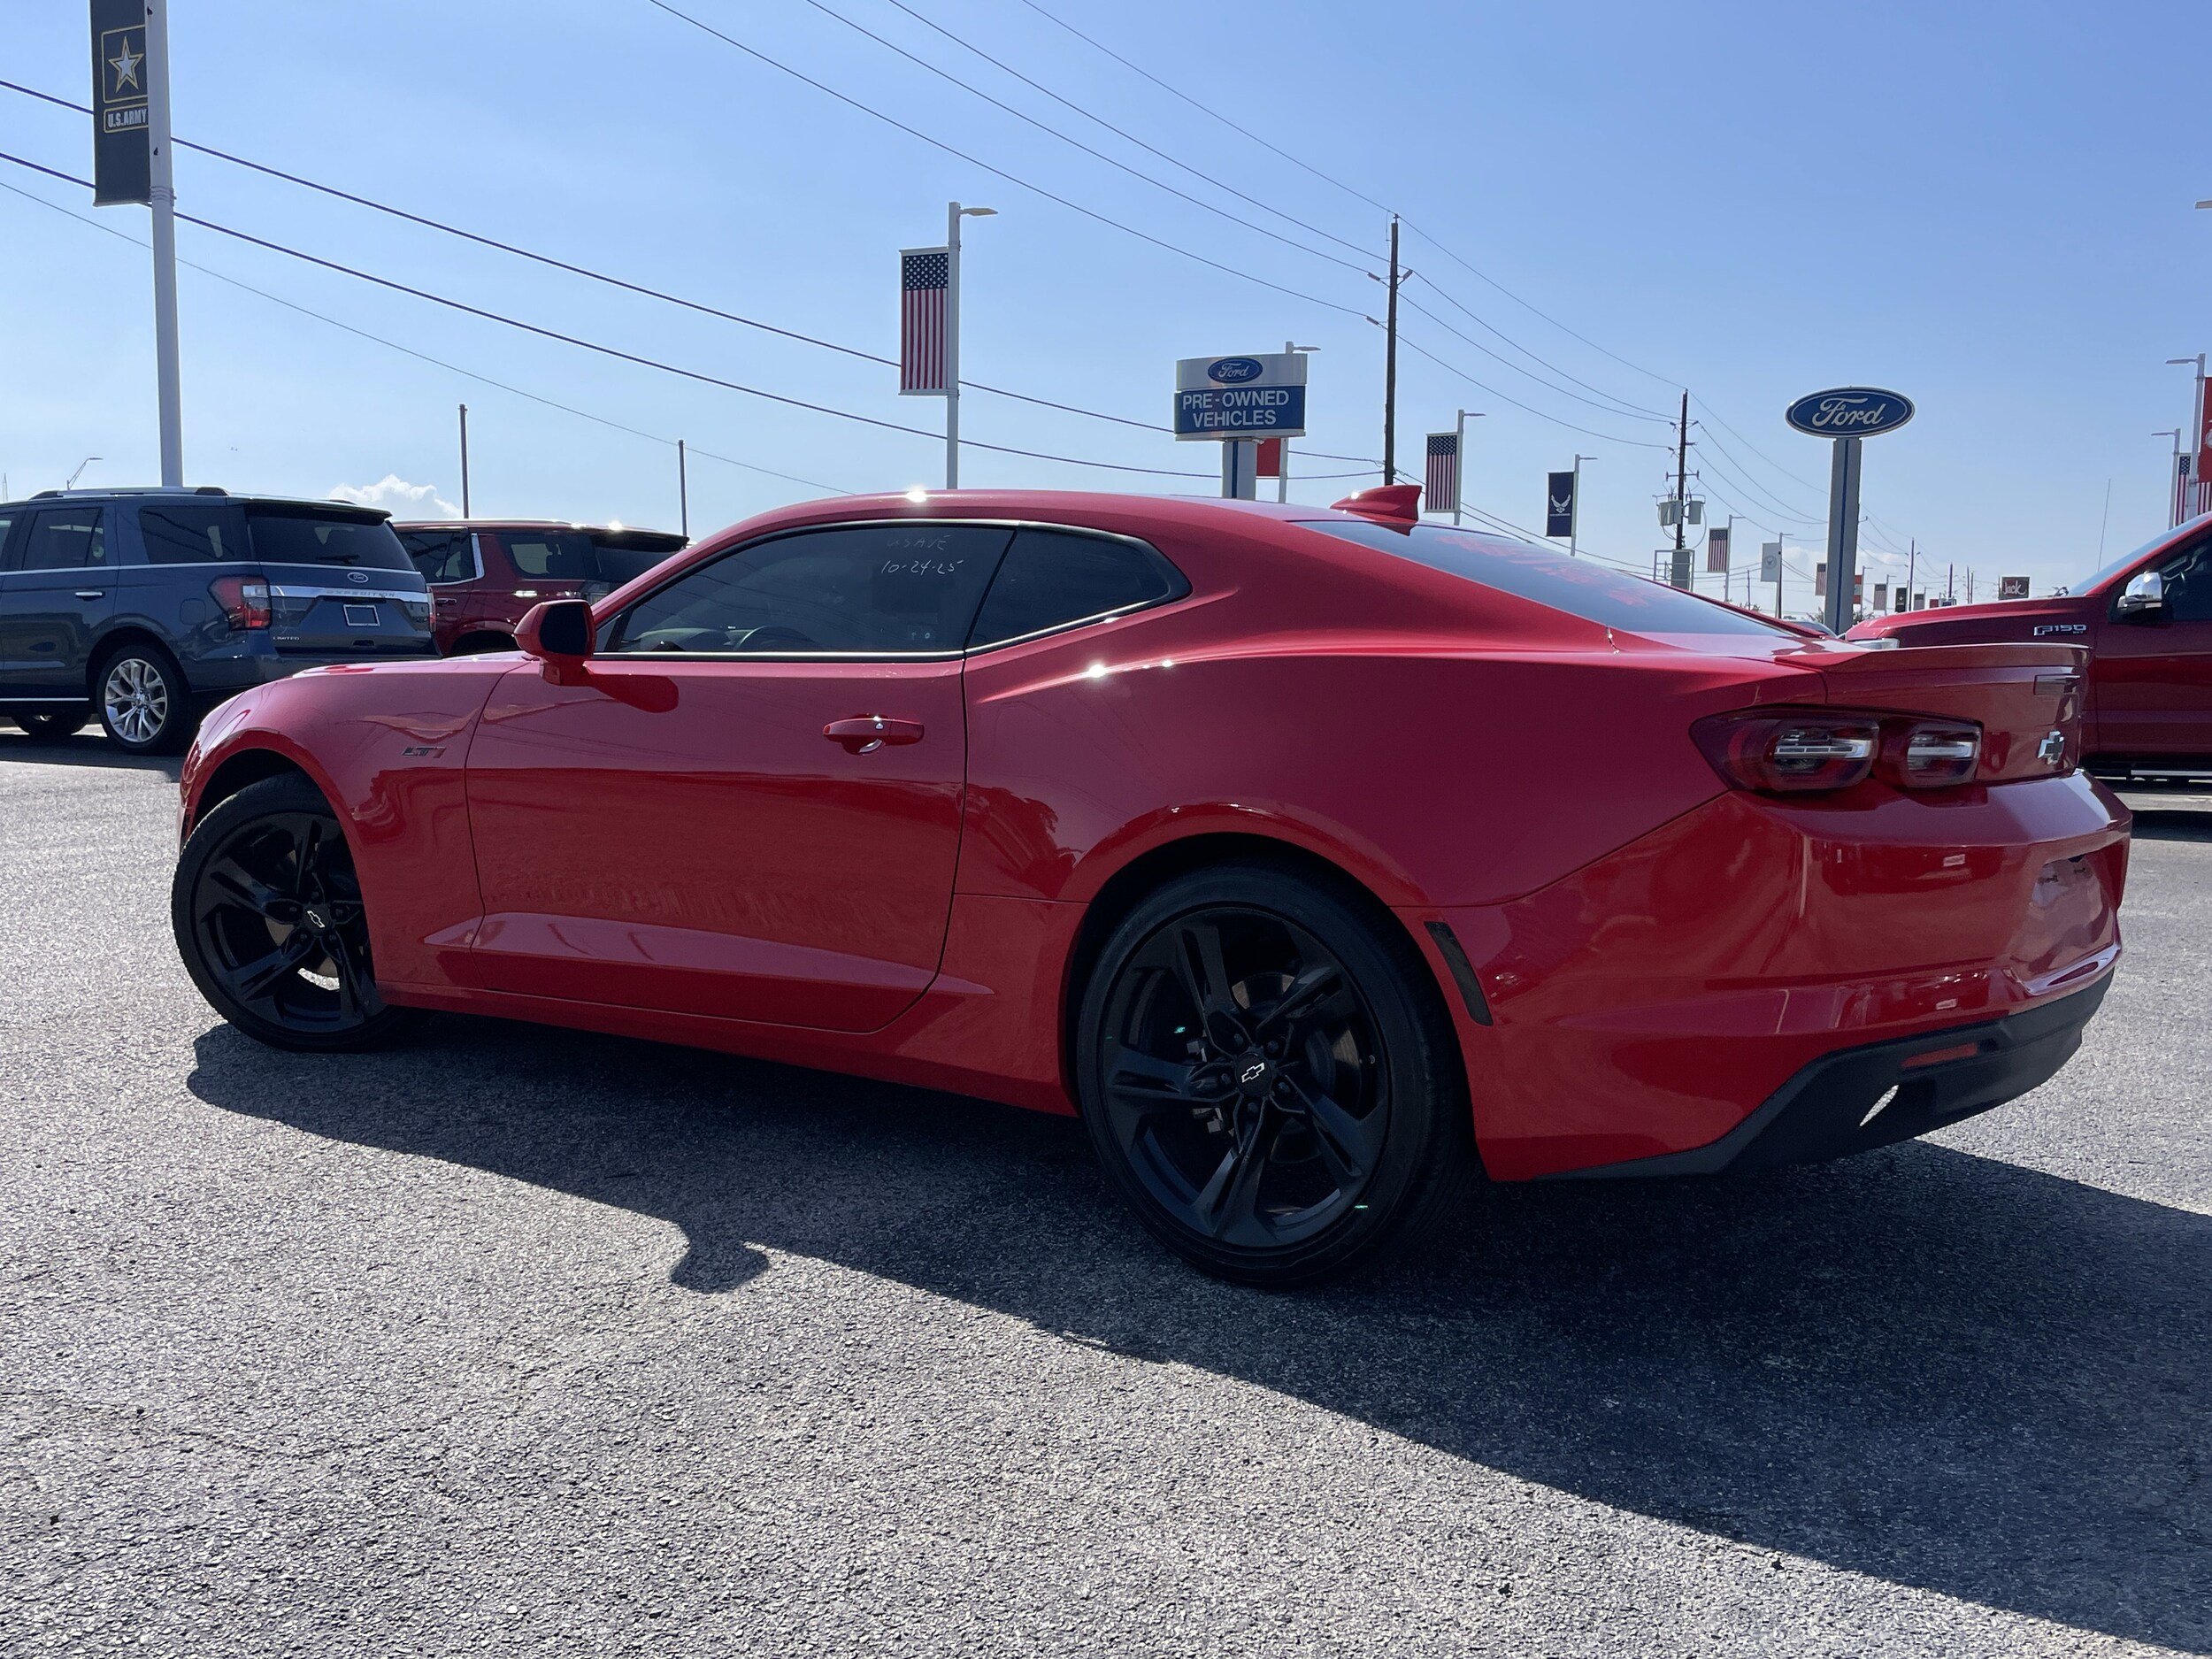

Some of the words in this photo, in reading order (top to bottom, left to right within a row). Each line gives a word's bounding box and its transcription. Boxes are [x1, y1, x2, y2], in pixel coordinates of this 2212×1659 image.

[1218, 363, 1250, 378] Ford
[1183, 390, 1289, 411] PRE-OWNED
[1193, 410, 1277, 427] VEHICLES
[1812, 397, 1886, 426] Ford
